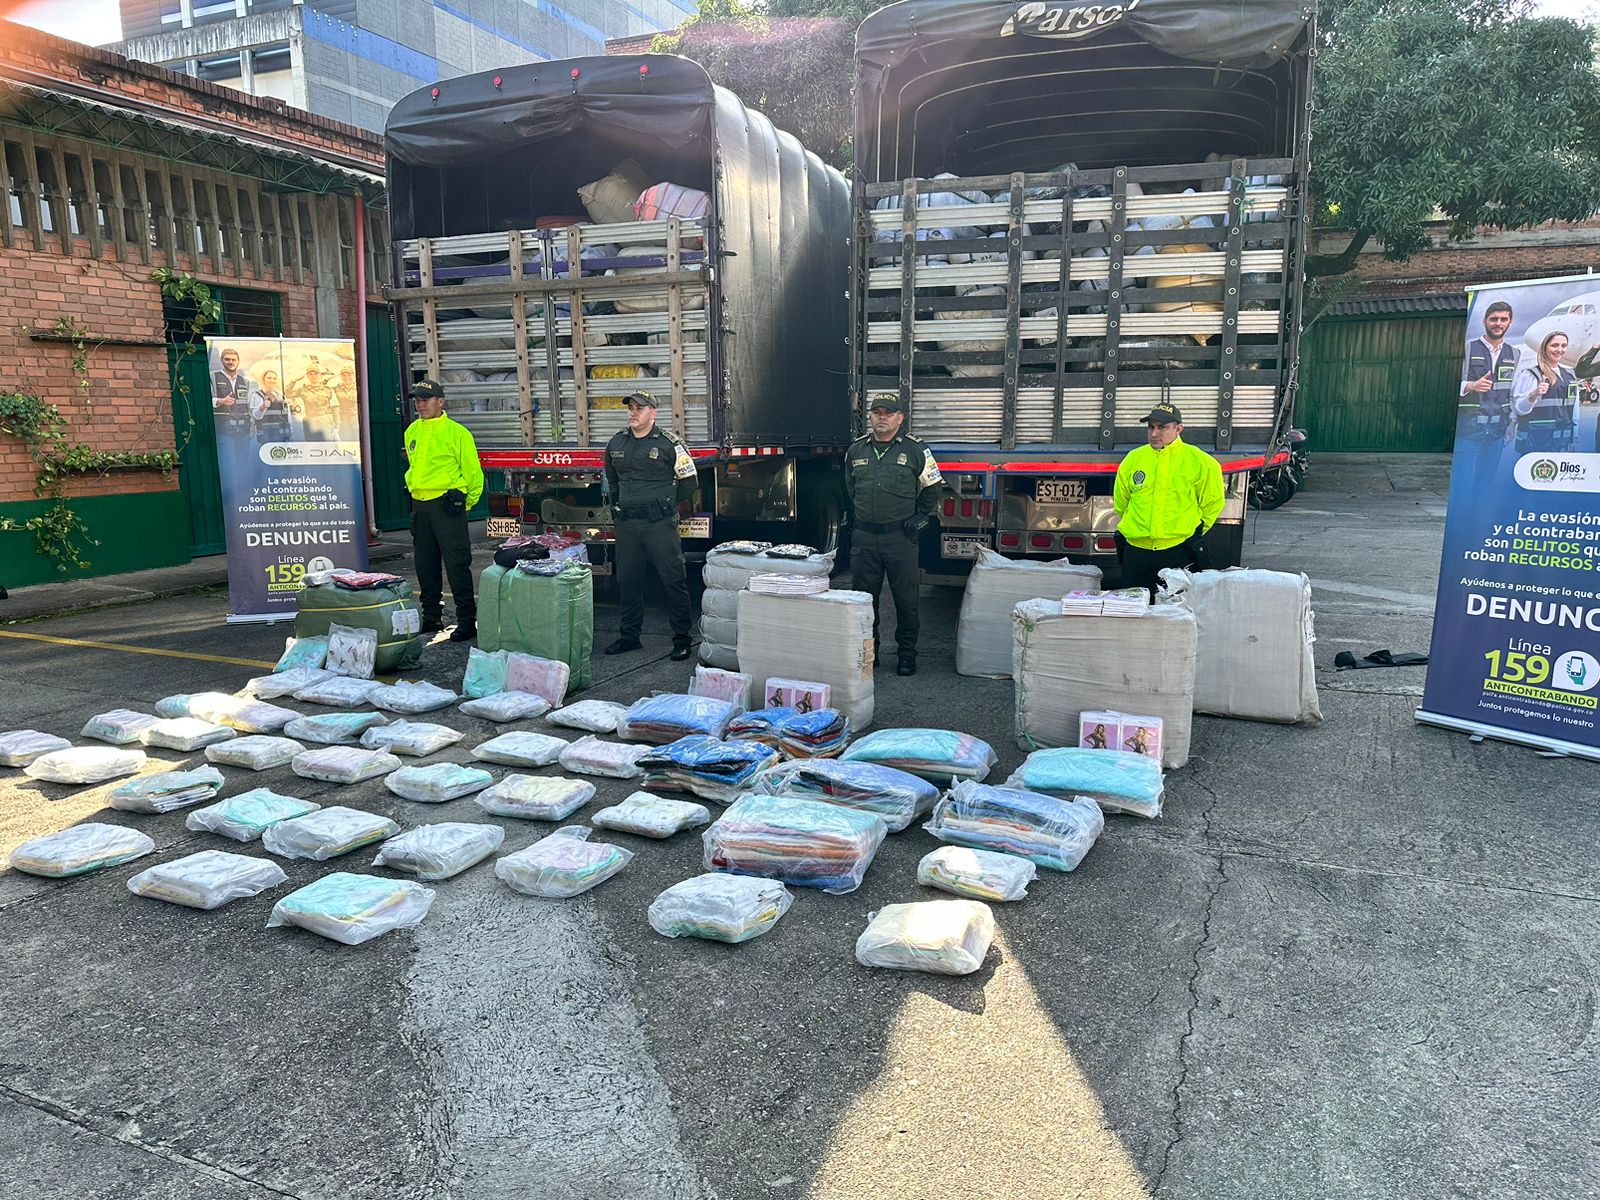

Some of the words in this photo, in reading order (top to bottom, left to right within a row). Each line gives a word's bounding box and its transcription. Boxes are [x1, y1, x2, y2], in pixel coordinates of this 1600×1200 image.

[874, 393, 897, 403] POLICIA
[310, 449, 357, 457] DIAN
[534, 453, 572, 465] SUTA
[1560, 461, 1580, 473] Dios
[268, 477, 279, 485] La
[281, 476, 317, 484] evasión
[254, 487, 260, 495] y
[262, 486, 271, 494] el
[273, 485, 332, 494] contrabando
[268, 494, 308, 502] DELITOS
[328, 493, 338, 501] le
[238, 504, 266, 512] roban
[267, 503, 318, 511] RECURSOS
[319, 502, 328, 510] al
[1518, 509, 1536, 522] La
[1539, 511, 1600, 526] evasión
[239, 522, 270, 530] Ayúdenos
[1492, 524, 1503, 536] y
[1505, 523, 1520, 535] el
[245, 529, 351, 547] DENUNCIE
[1484, 538, 1509, 549] son
[1512, 538, 1580, 555] DELITOS
[278, 555, 305, 564] Línea
[1464, 549, 1505, 563] roban
[1508, 552, 1593, 571] RECURSOS
[264, 563, 306, 583] 159
[1460, 577, 1506, 589] Ayúdenos
[1515, 584, 1560, 595] proteger
[1561, 587, 1572, 596] lo
[1573, 590, 1594, 599] que
[1466, 593, 1600, 632] DENUNC
[1508, 637, 1552, 656] Línea
[1484, 649, 1550, 684] 159
[1485, 681, 1595, 707] ANTICONTRABANDO
[1478, 700, 1502, 711] Juntos
[1503, 706, 1551, 720] protegemos
[1552, 712, 1561, 721] lo
[1562, 717, 1594, 728] nuestro
